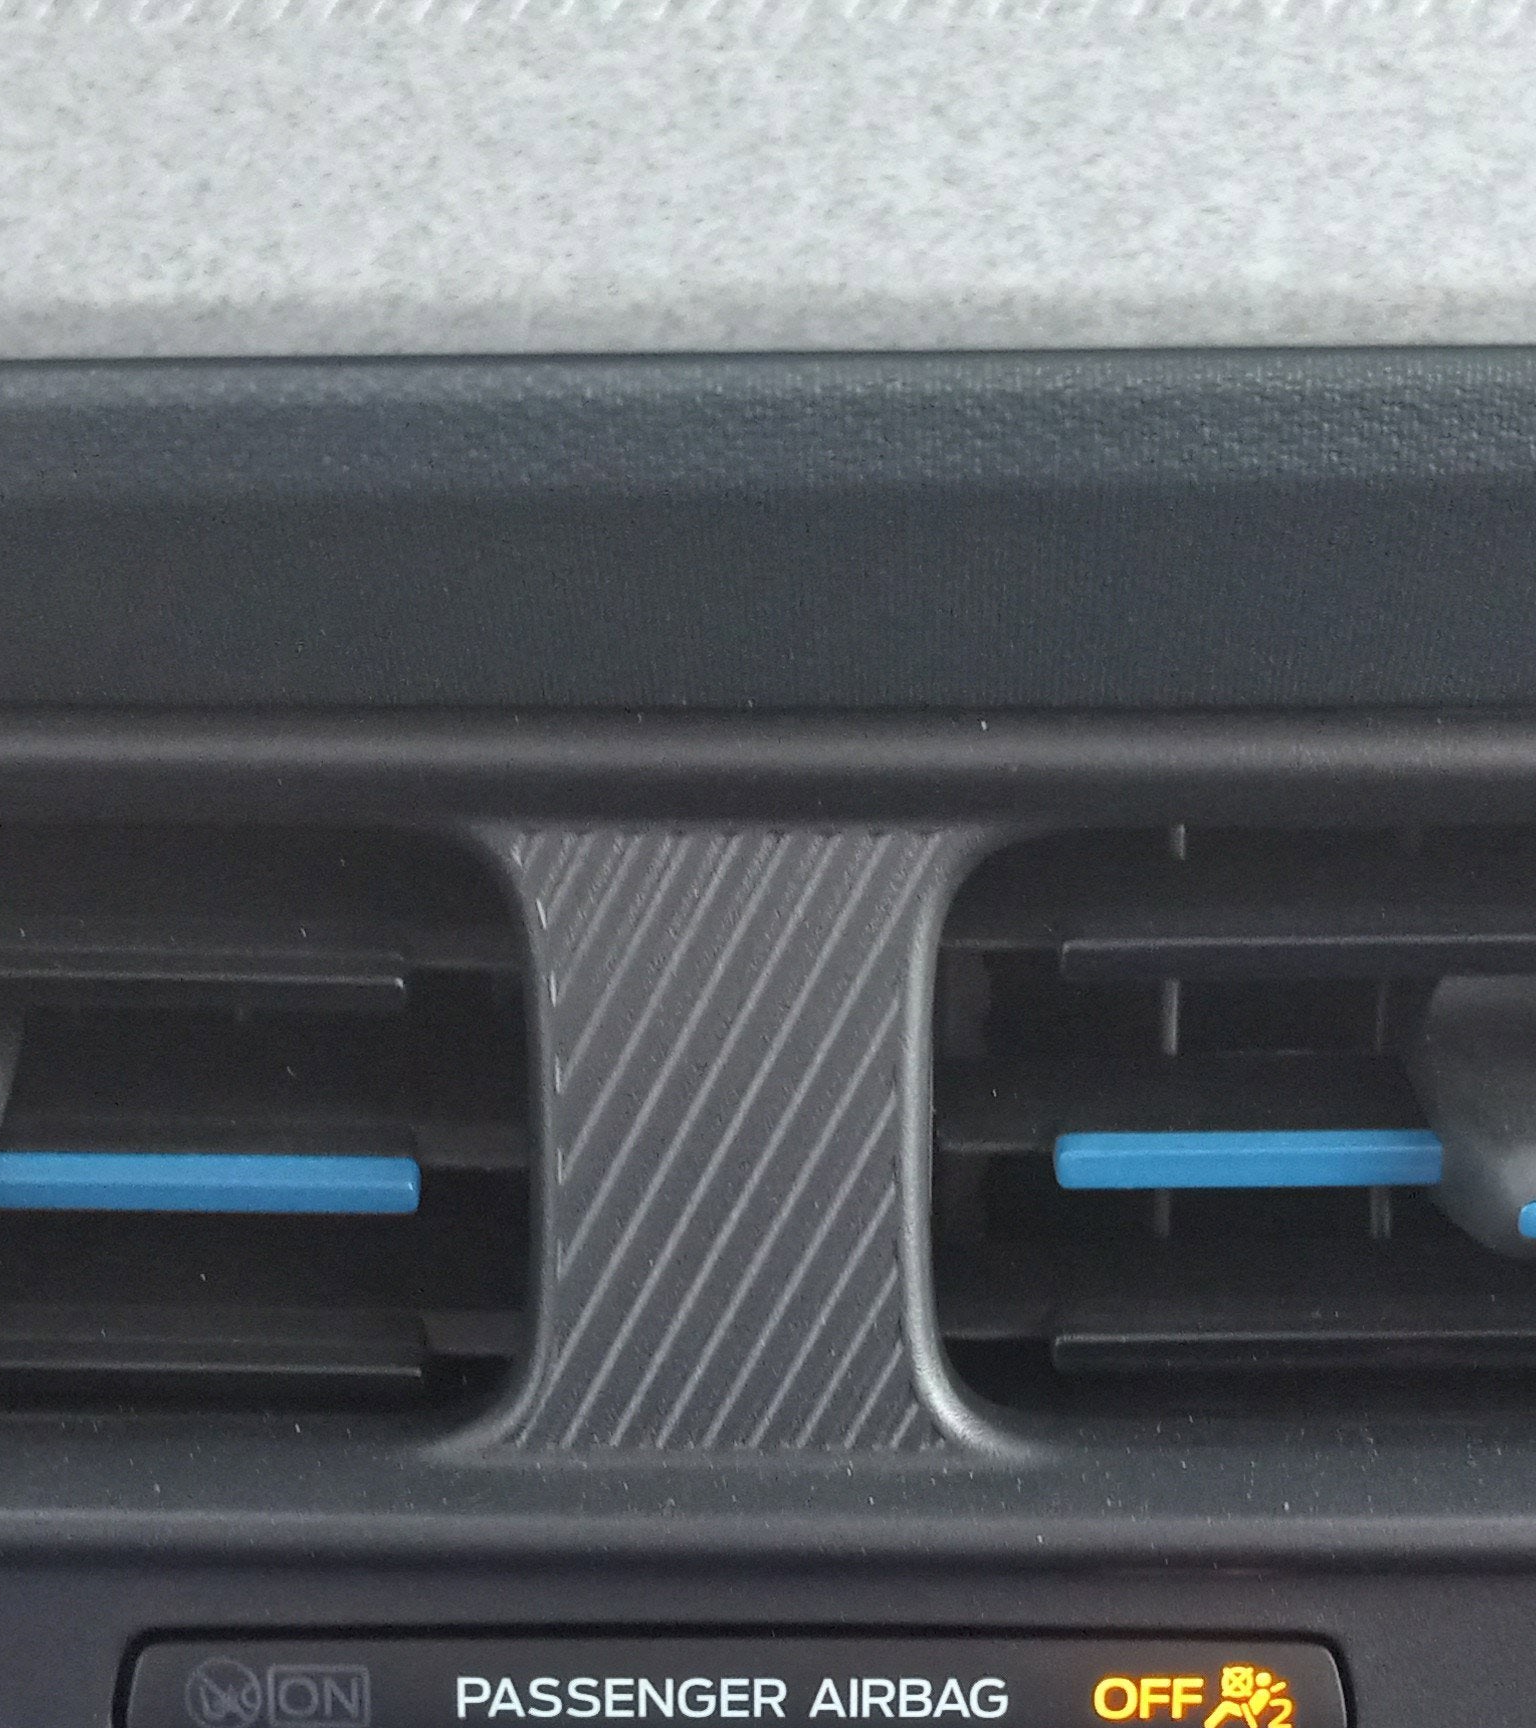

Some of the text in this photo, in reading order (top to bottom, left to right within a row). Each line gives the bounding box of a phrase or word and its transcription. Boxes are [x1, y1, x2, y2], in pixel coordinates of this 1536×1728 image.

[278, 1677, 360, 1718] ON
[456, 1676, 1009, 1719] PASSENGER AIRBAG
[1093, 1676, 1205, 1720] OFF
